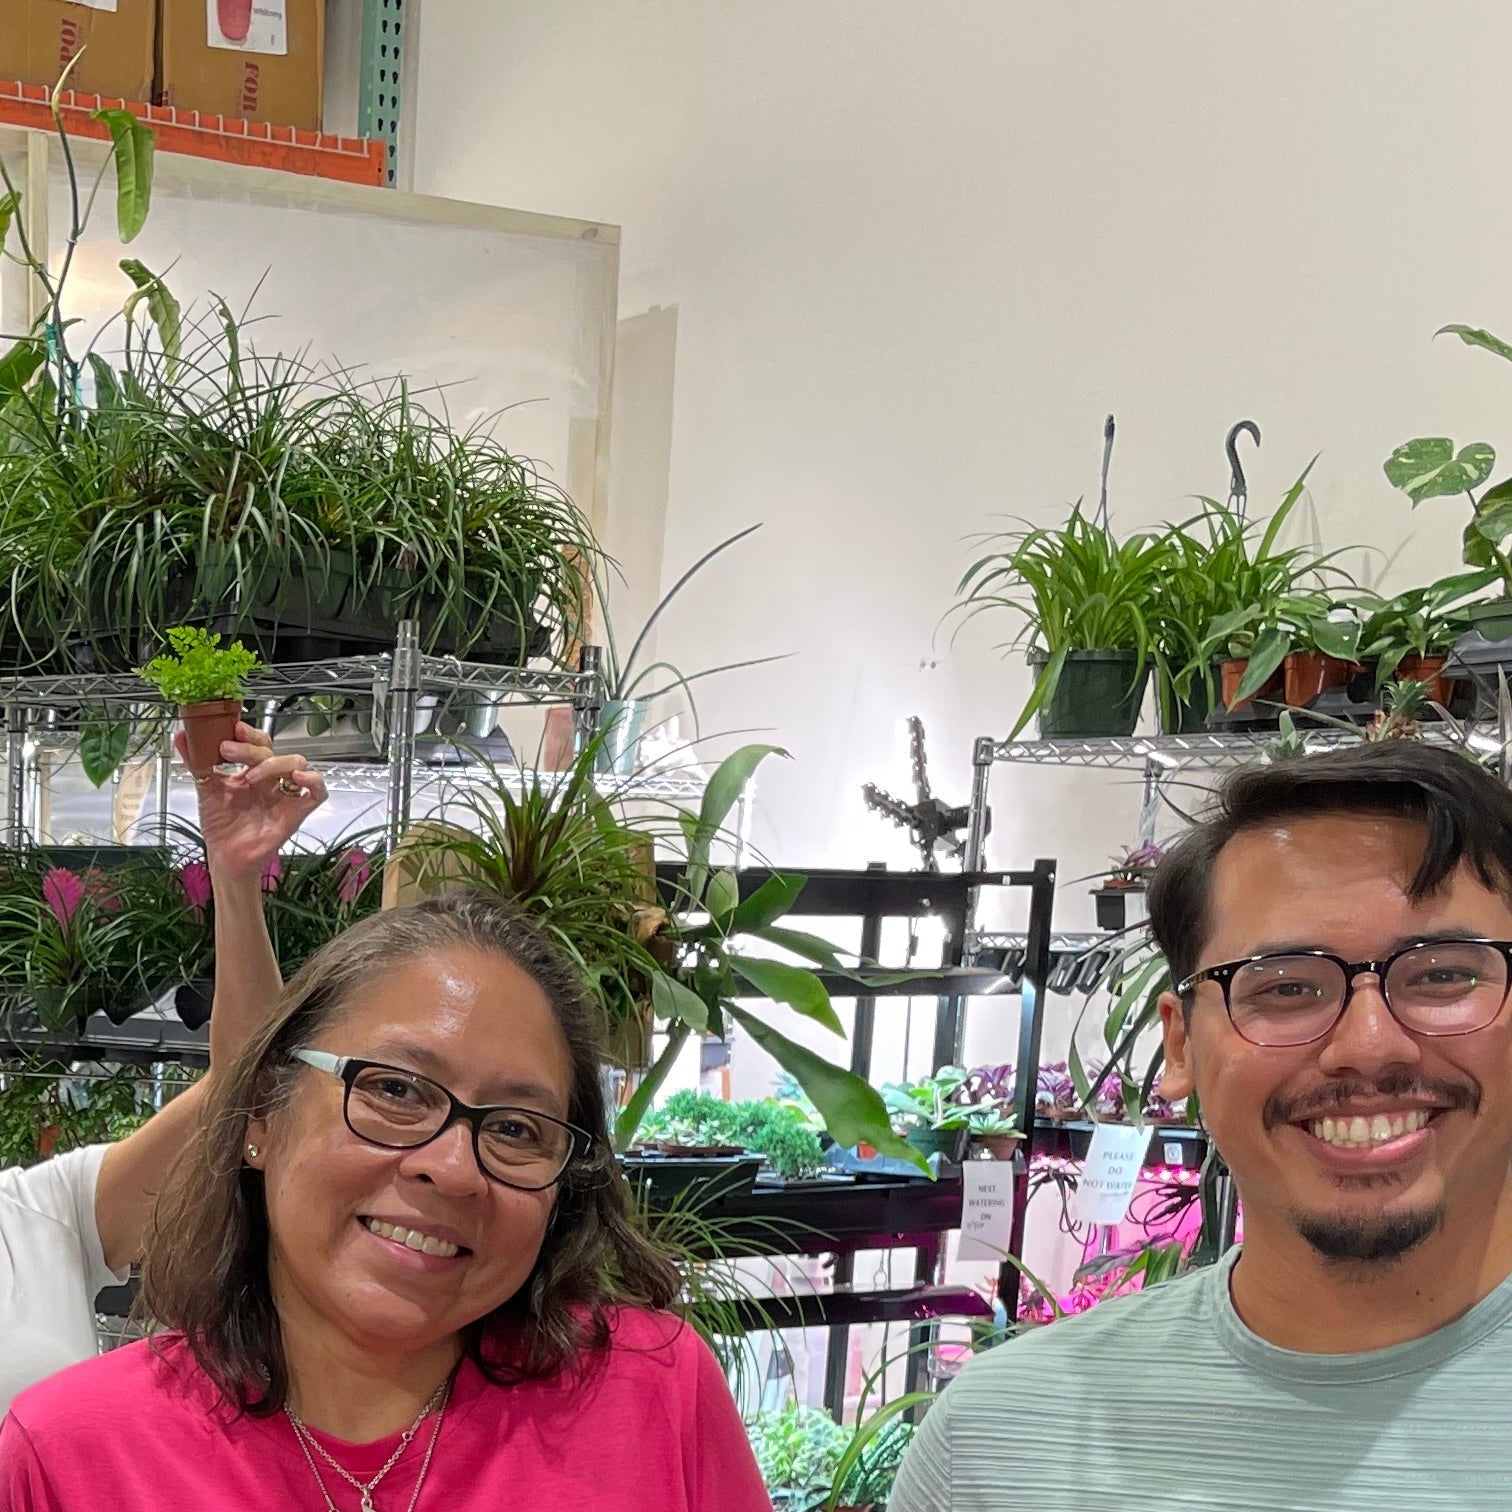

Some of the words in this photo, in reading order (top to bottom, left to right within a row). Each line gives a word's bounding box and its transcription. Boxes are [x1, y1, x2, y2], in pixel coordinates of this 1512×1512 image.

[1102, 1151, 1135, 1161] PLEASE
[1108, 1166, 1123, 1175] DO
[1083, 1178, 1104, 1189] NOT
[978, 1184, 996, 1193] NEXT
[968, 1199, 1006, 1208] WATERING
[980, 1212, 992, 1221] ON
